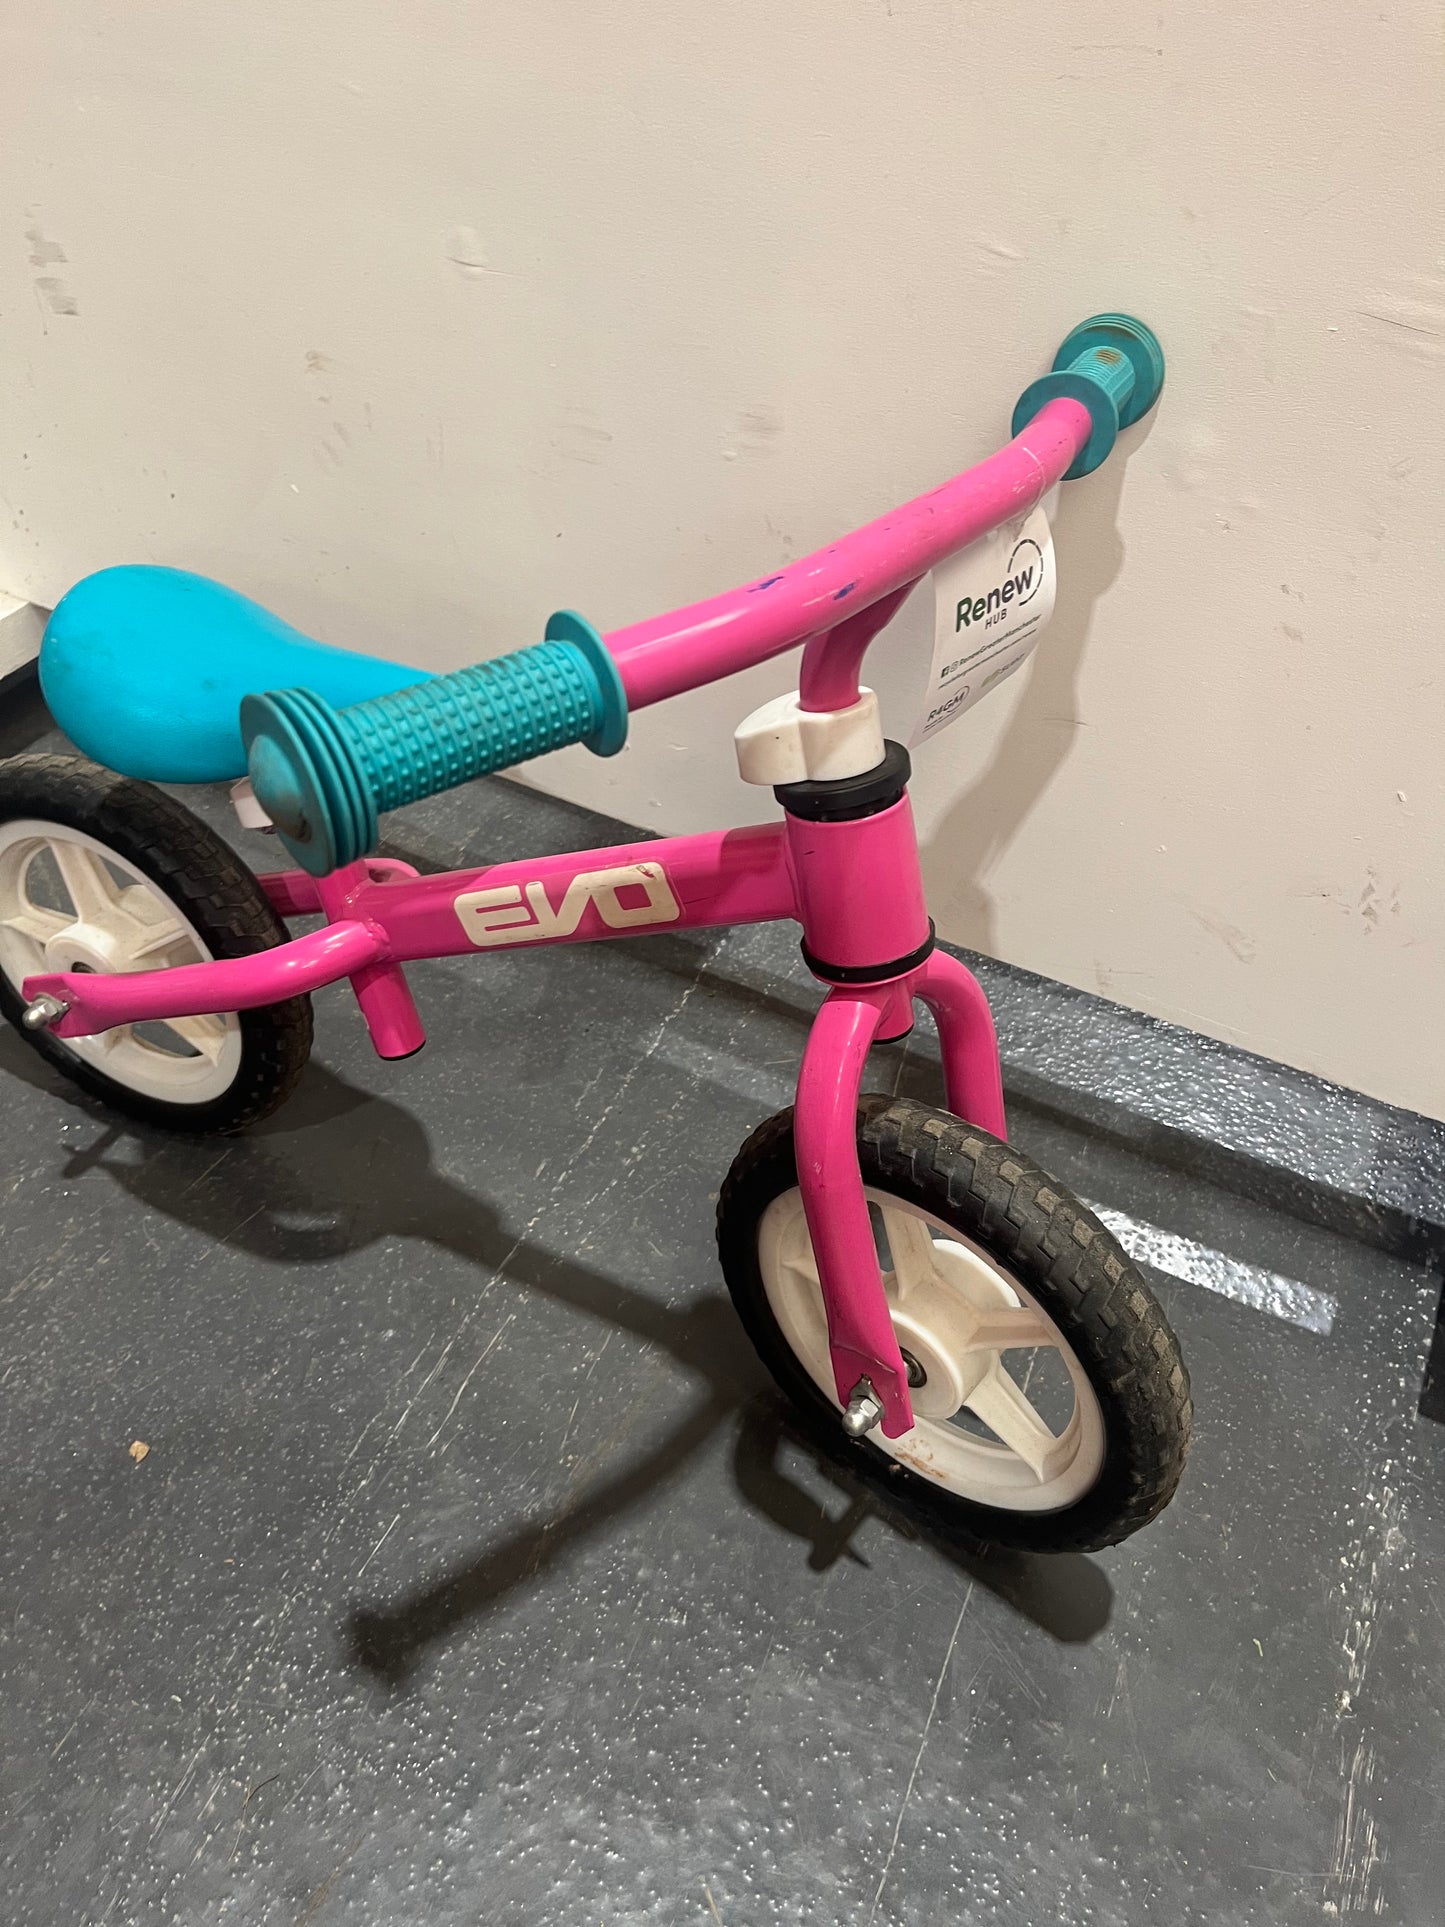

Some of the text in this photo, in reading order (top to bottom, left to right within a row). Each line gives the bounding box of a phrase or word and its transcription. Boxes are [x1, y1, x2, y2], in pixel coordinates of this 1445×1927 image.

[955, 565, 1033, 633] Renew
[985, 608, 1007, 630] HUB
[454, 861, 680, 947] EVO
